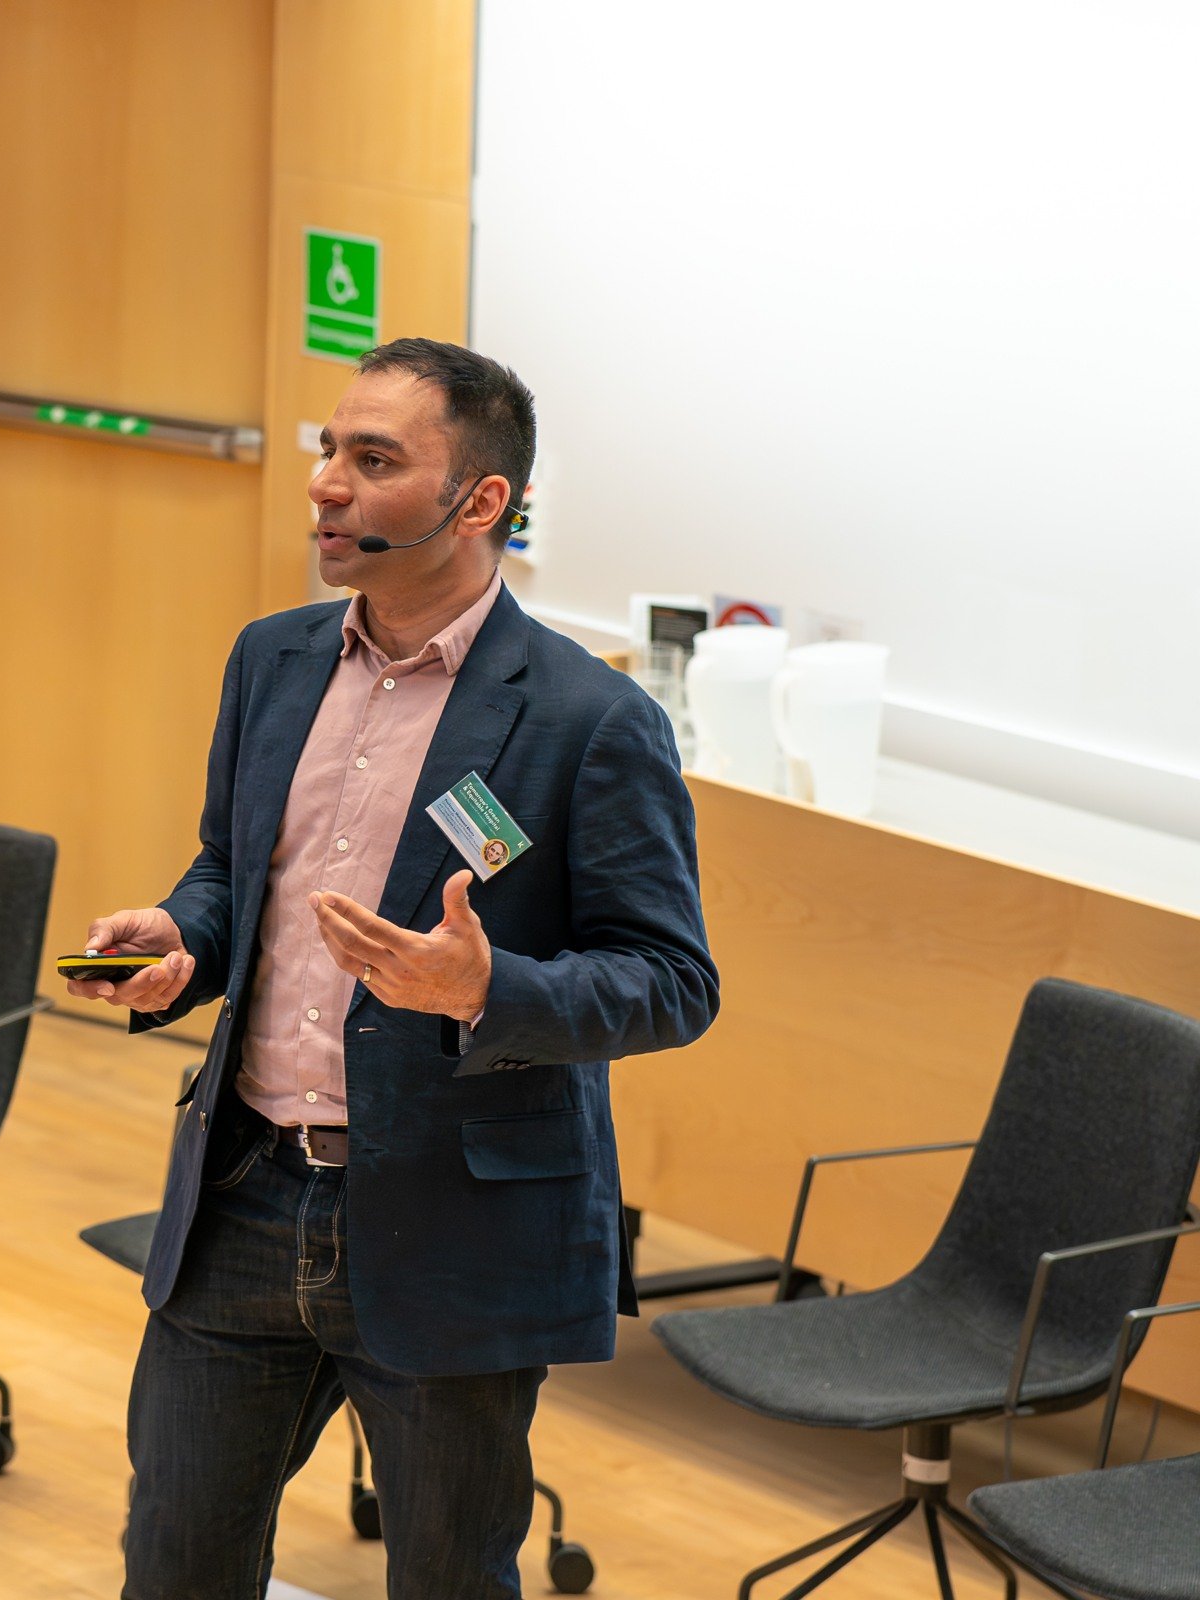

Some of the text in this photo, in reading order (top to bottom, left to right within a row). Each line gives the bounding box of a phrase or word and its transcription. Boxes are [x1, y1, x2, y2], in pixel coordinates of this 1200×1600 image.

[466, 790, 485, 813] Equitable
[483, 809, 500, 831] Hospital
[467, 782, 489, 809] Tomorrow's
[488, 807, 500, 823] Green
